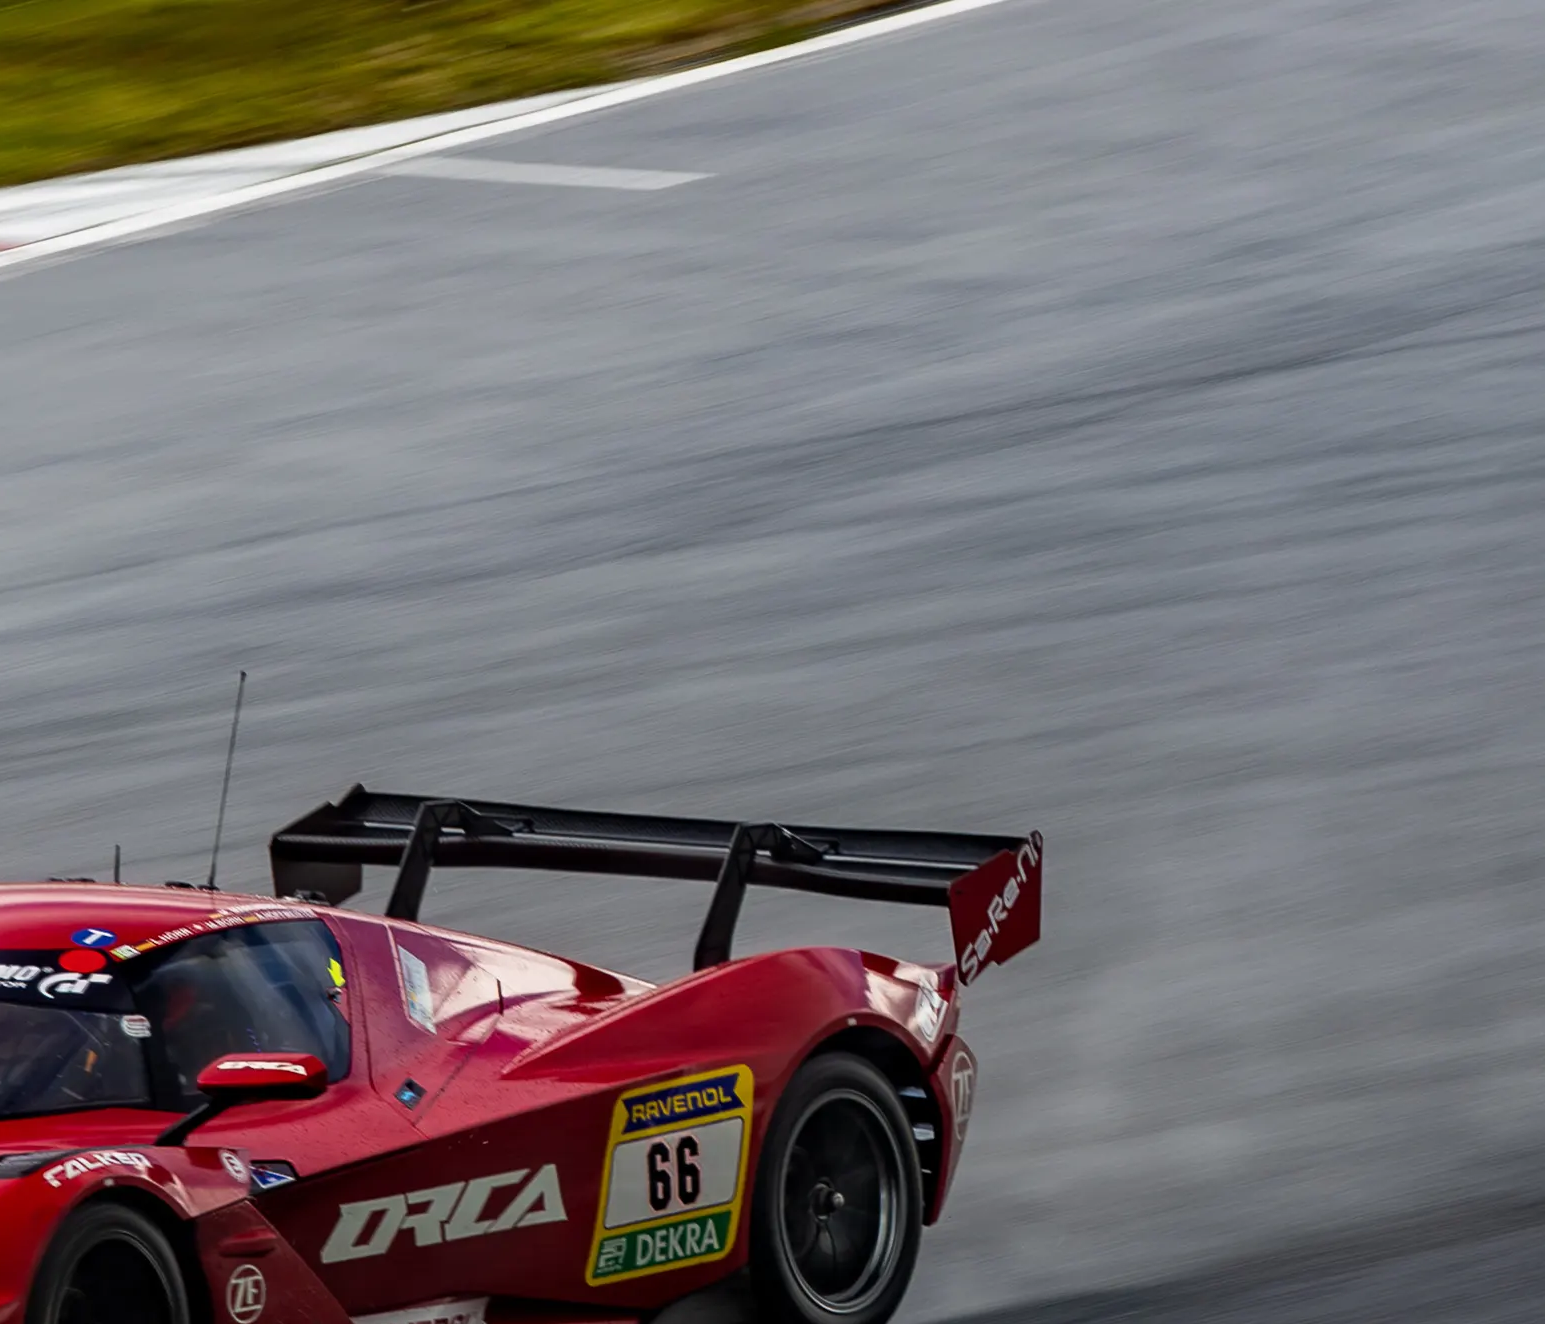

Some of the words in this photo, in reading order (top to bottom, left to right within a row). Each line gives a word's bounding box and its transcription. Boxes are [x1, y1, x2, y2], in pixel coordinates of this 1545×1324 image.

[630, 1085, 733, 1124] RAVENOL
[42, 1151, 153, 1189] FALKEN
[647, 1135, 701, 1212] 66
[319, 1162, 569, 1265] ORCA
[634, 1218, 721, 1267] DEKRA
